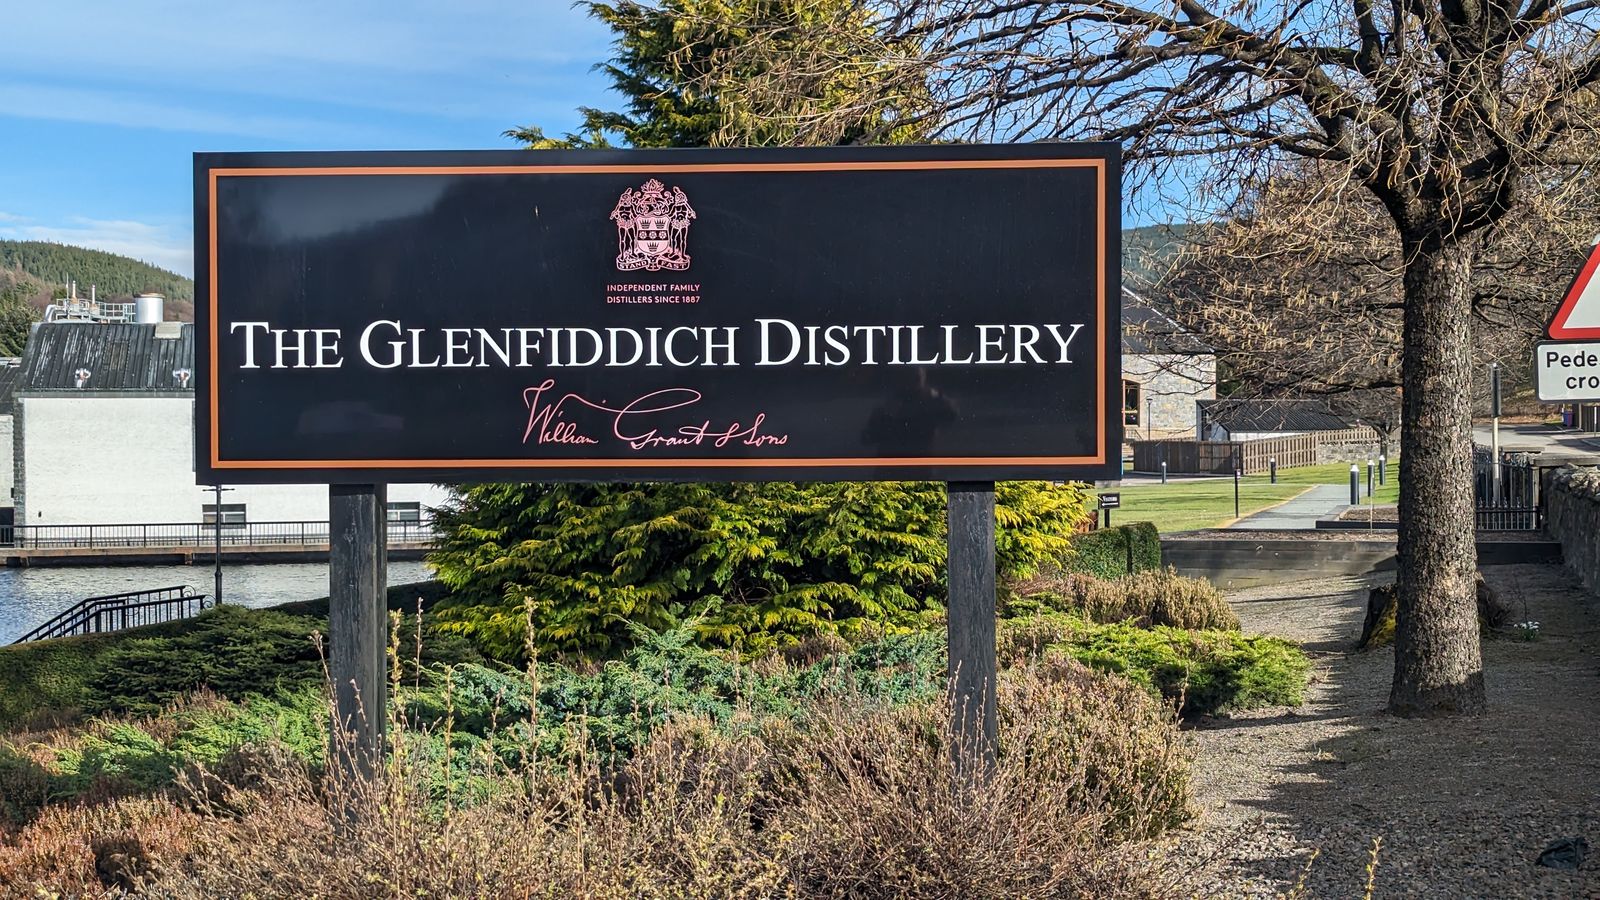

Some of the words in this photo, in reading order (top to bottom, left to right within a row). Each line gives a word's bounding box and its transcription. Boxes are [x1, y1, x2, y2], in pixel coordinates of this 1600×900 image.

[619, 260, 647, 269] STAND
[660, 261, 687, 269] FAST
[606, 283, 667, 292] INDEPENDENT
[670, 283, 700, 292] FAMILY
[607, 295, 652, 304] DISTILLERS
[655, 295, 679, 304] SINCE
[682, 295, 700, 304] 1887
[230, 321, 343, 370] THE
[359, 319, 740, 369] GLENFIDDICH
[755, 318, 1085, 367] DISTILLERY
[1546, 351, 1600, 368] Pede
[523, 379, 602, 445] William
[614, 388, 710, 449] Grant
[743, 413, 788, 446] Sons
